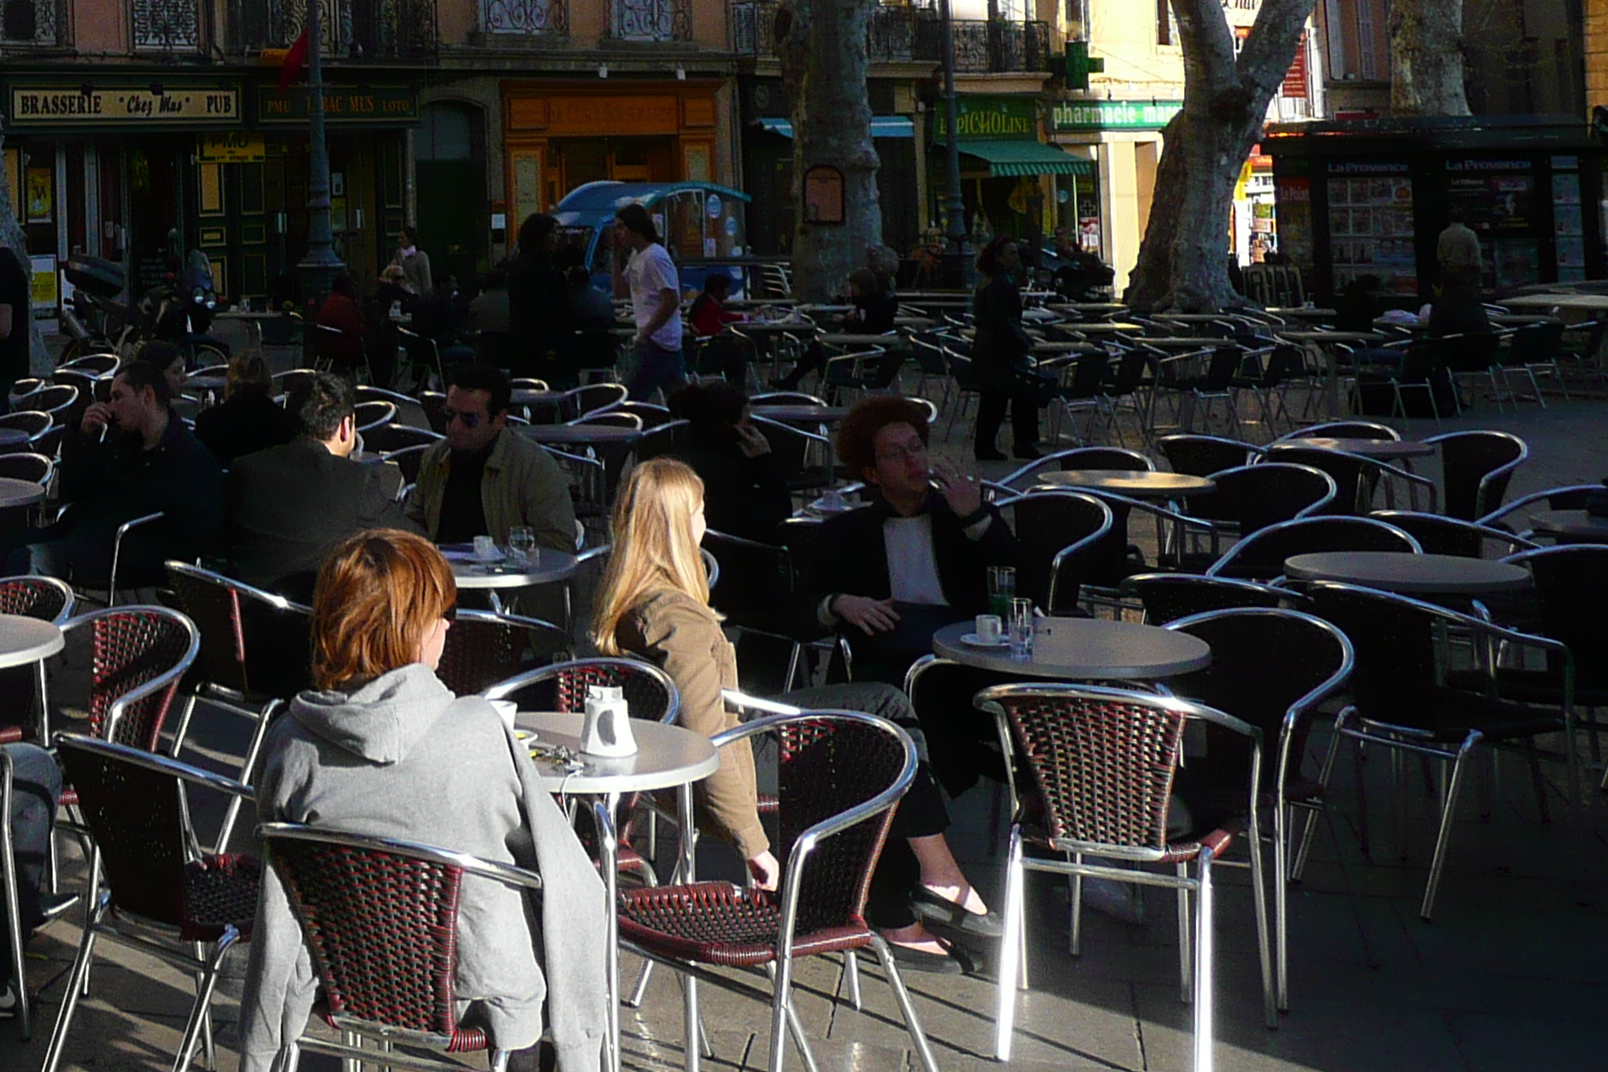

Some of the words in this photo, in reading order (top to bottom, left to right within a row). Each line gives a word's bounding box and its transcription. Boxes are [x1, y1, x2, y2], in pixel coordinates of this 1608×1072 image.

[20, 95, 102, 115] BRASSERIE
[205, 95, 232, 113] PUB
[266, 100, 293, 113] PMU
[303, 95, 343, 112] TBAC
[349, 95, 375, 112] MUS
[382, 99, 411, 113] LOTO
[1053, 102, 1136, 130] pharmacie
[1327, 162, 1344, 173] La
[1345, 162, 1410, 173] Provence
[1444, 159, 1463, 171] La
[1464, 158, 1533, 171] Provence
